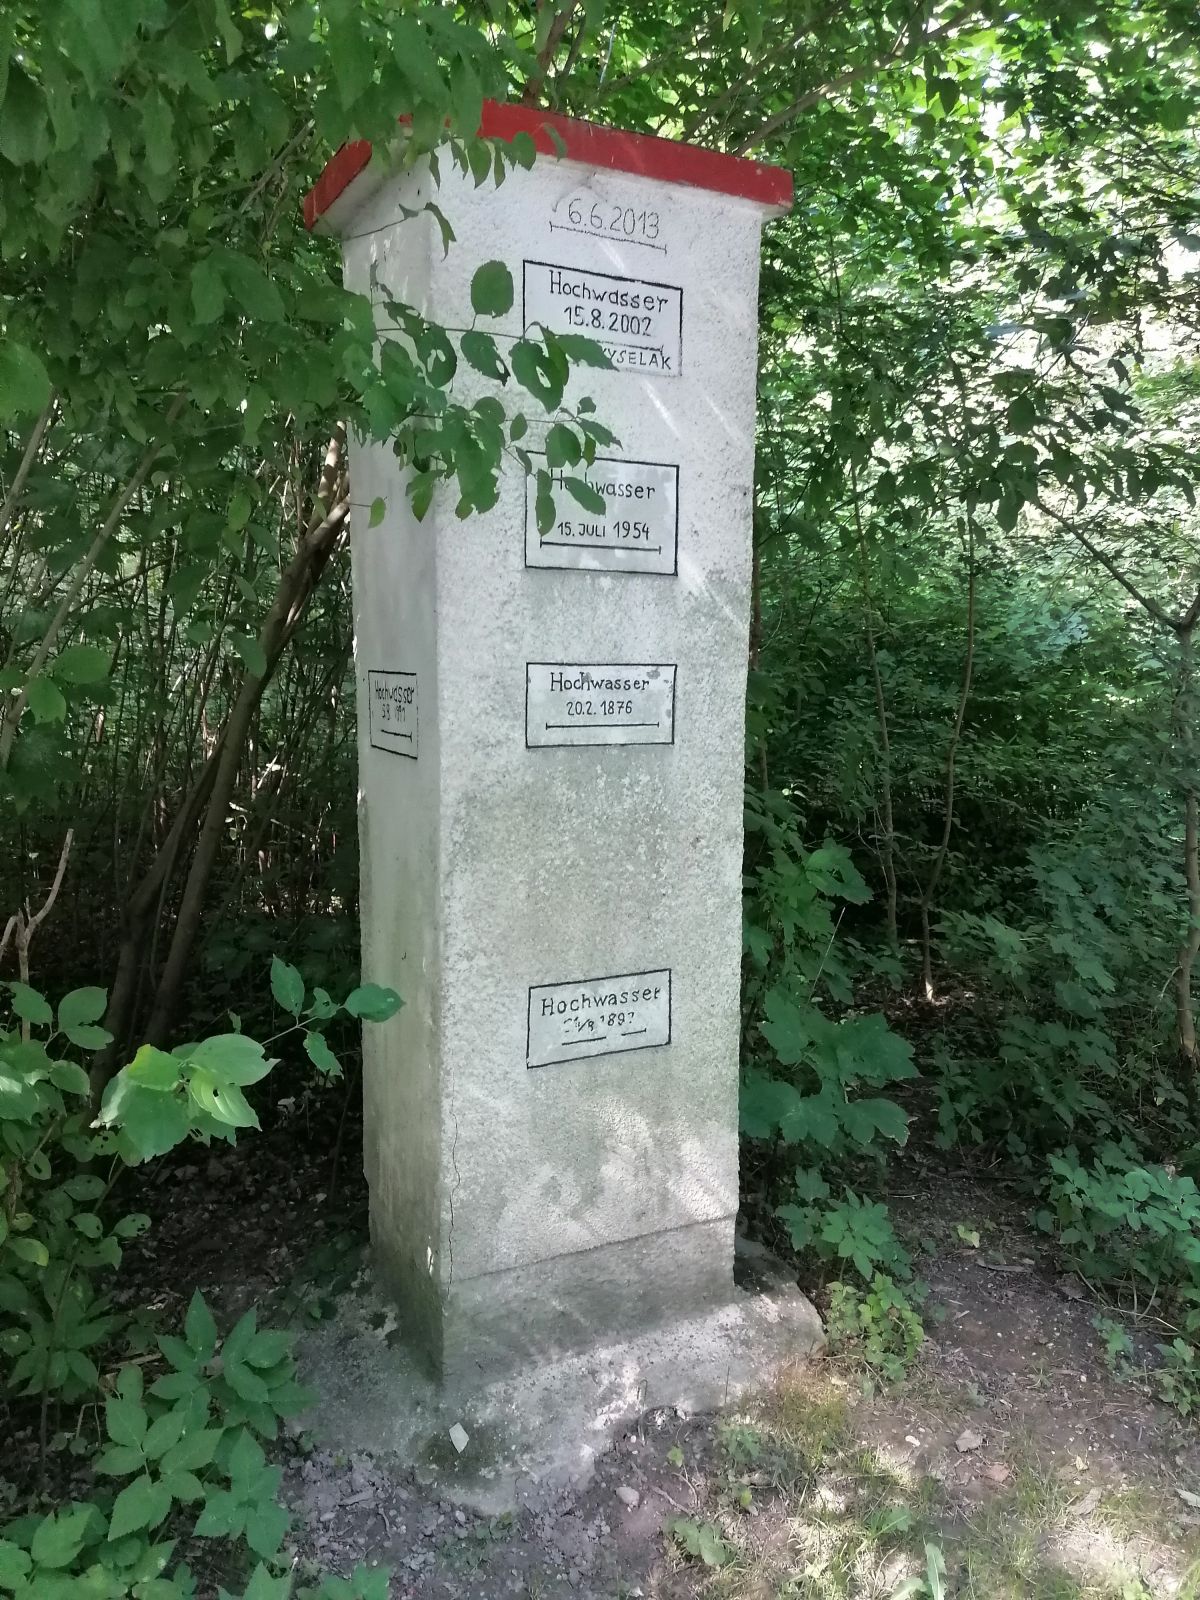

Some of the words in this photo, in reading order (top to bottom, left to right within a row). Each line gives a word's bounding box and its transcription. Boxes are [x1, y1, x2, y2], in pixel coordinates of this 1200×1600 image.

[568, 198, 660, 239] 6.6.2013
[549, 270, 669, 312] Hochwasser
[563, 305, 652, 338] 15.8.2002
[602, 347, 672, 370] YSELAK
[578, 523, 606, 538] JULI
[613, 520, 650, 541] 1954
[550, 671, 650, 692] Hochwasser
[541, 986, 662, 1017] Hochwasser
